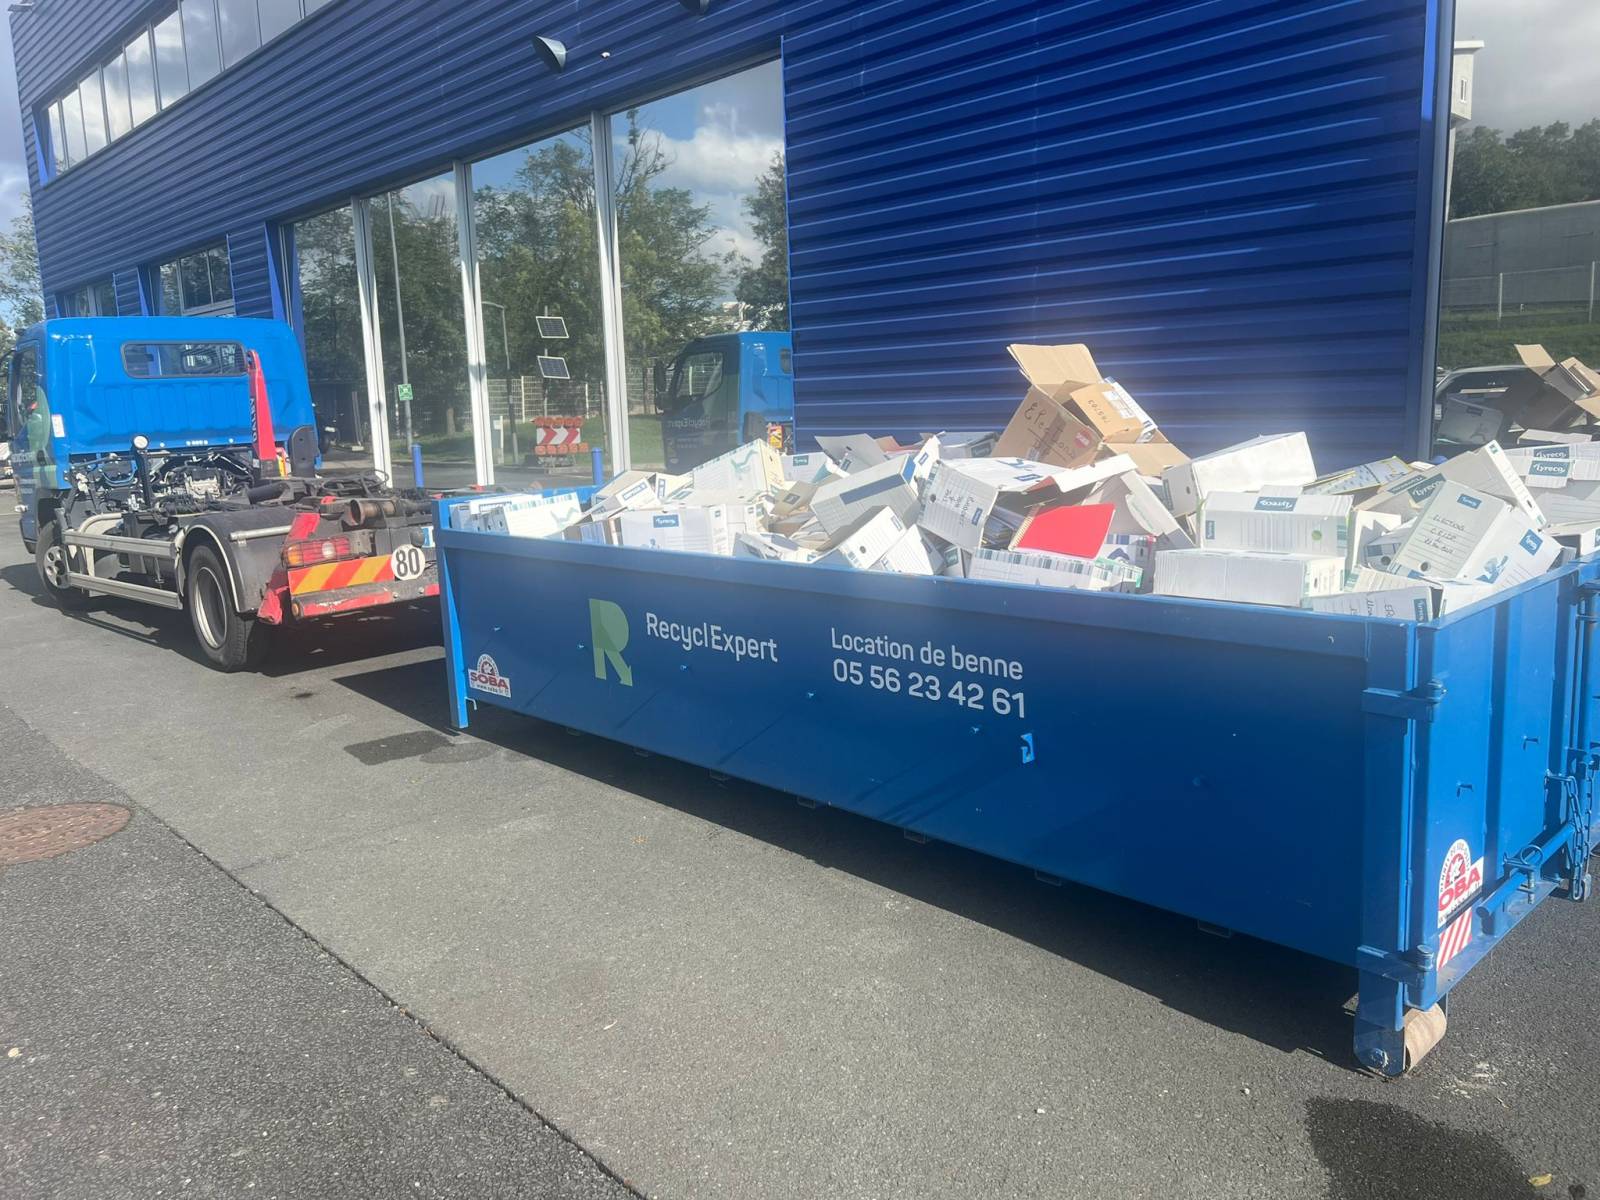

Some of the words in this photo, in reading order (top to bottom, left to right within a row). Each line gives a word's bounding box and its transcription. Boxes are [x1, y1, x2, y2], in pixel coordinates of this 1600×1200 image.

[396, 549, 421, 577] 80
[646, 612, 778, 662] RecyclExpert
[831, 627, 914, 662] Location
[920, 641, 945, 667] de
[951, 645, 1023, 680] benne
[470, 671, 508, 689] SOBA
[833, 658, 864, 685] 05
[870, 665, 901, 692] 56
[908, 672, 941, 700] 23
[947, 681, 984, 710] 42
[992, 688, 1025, 718] 61
